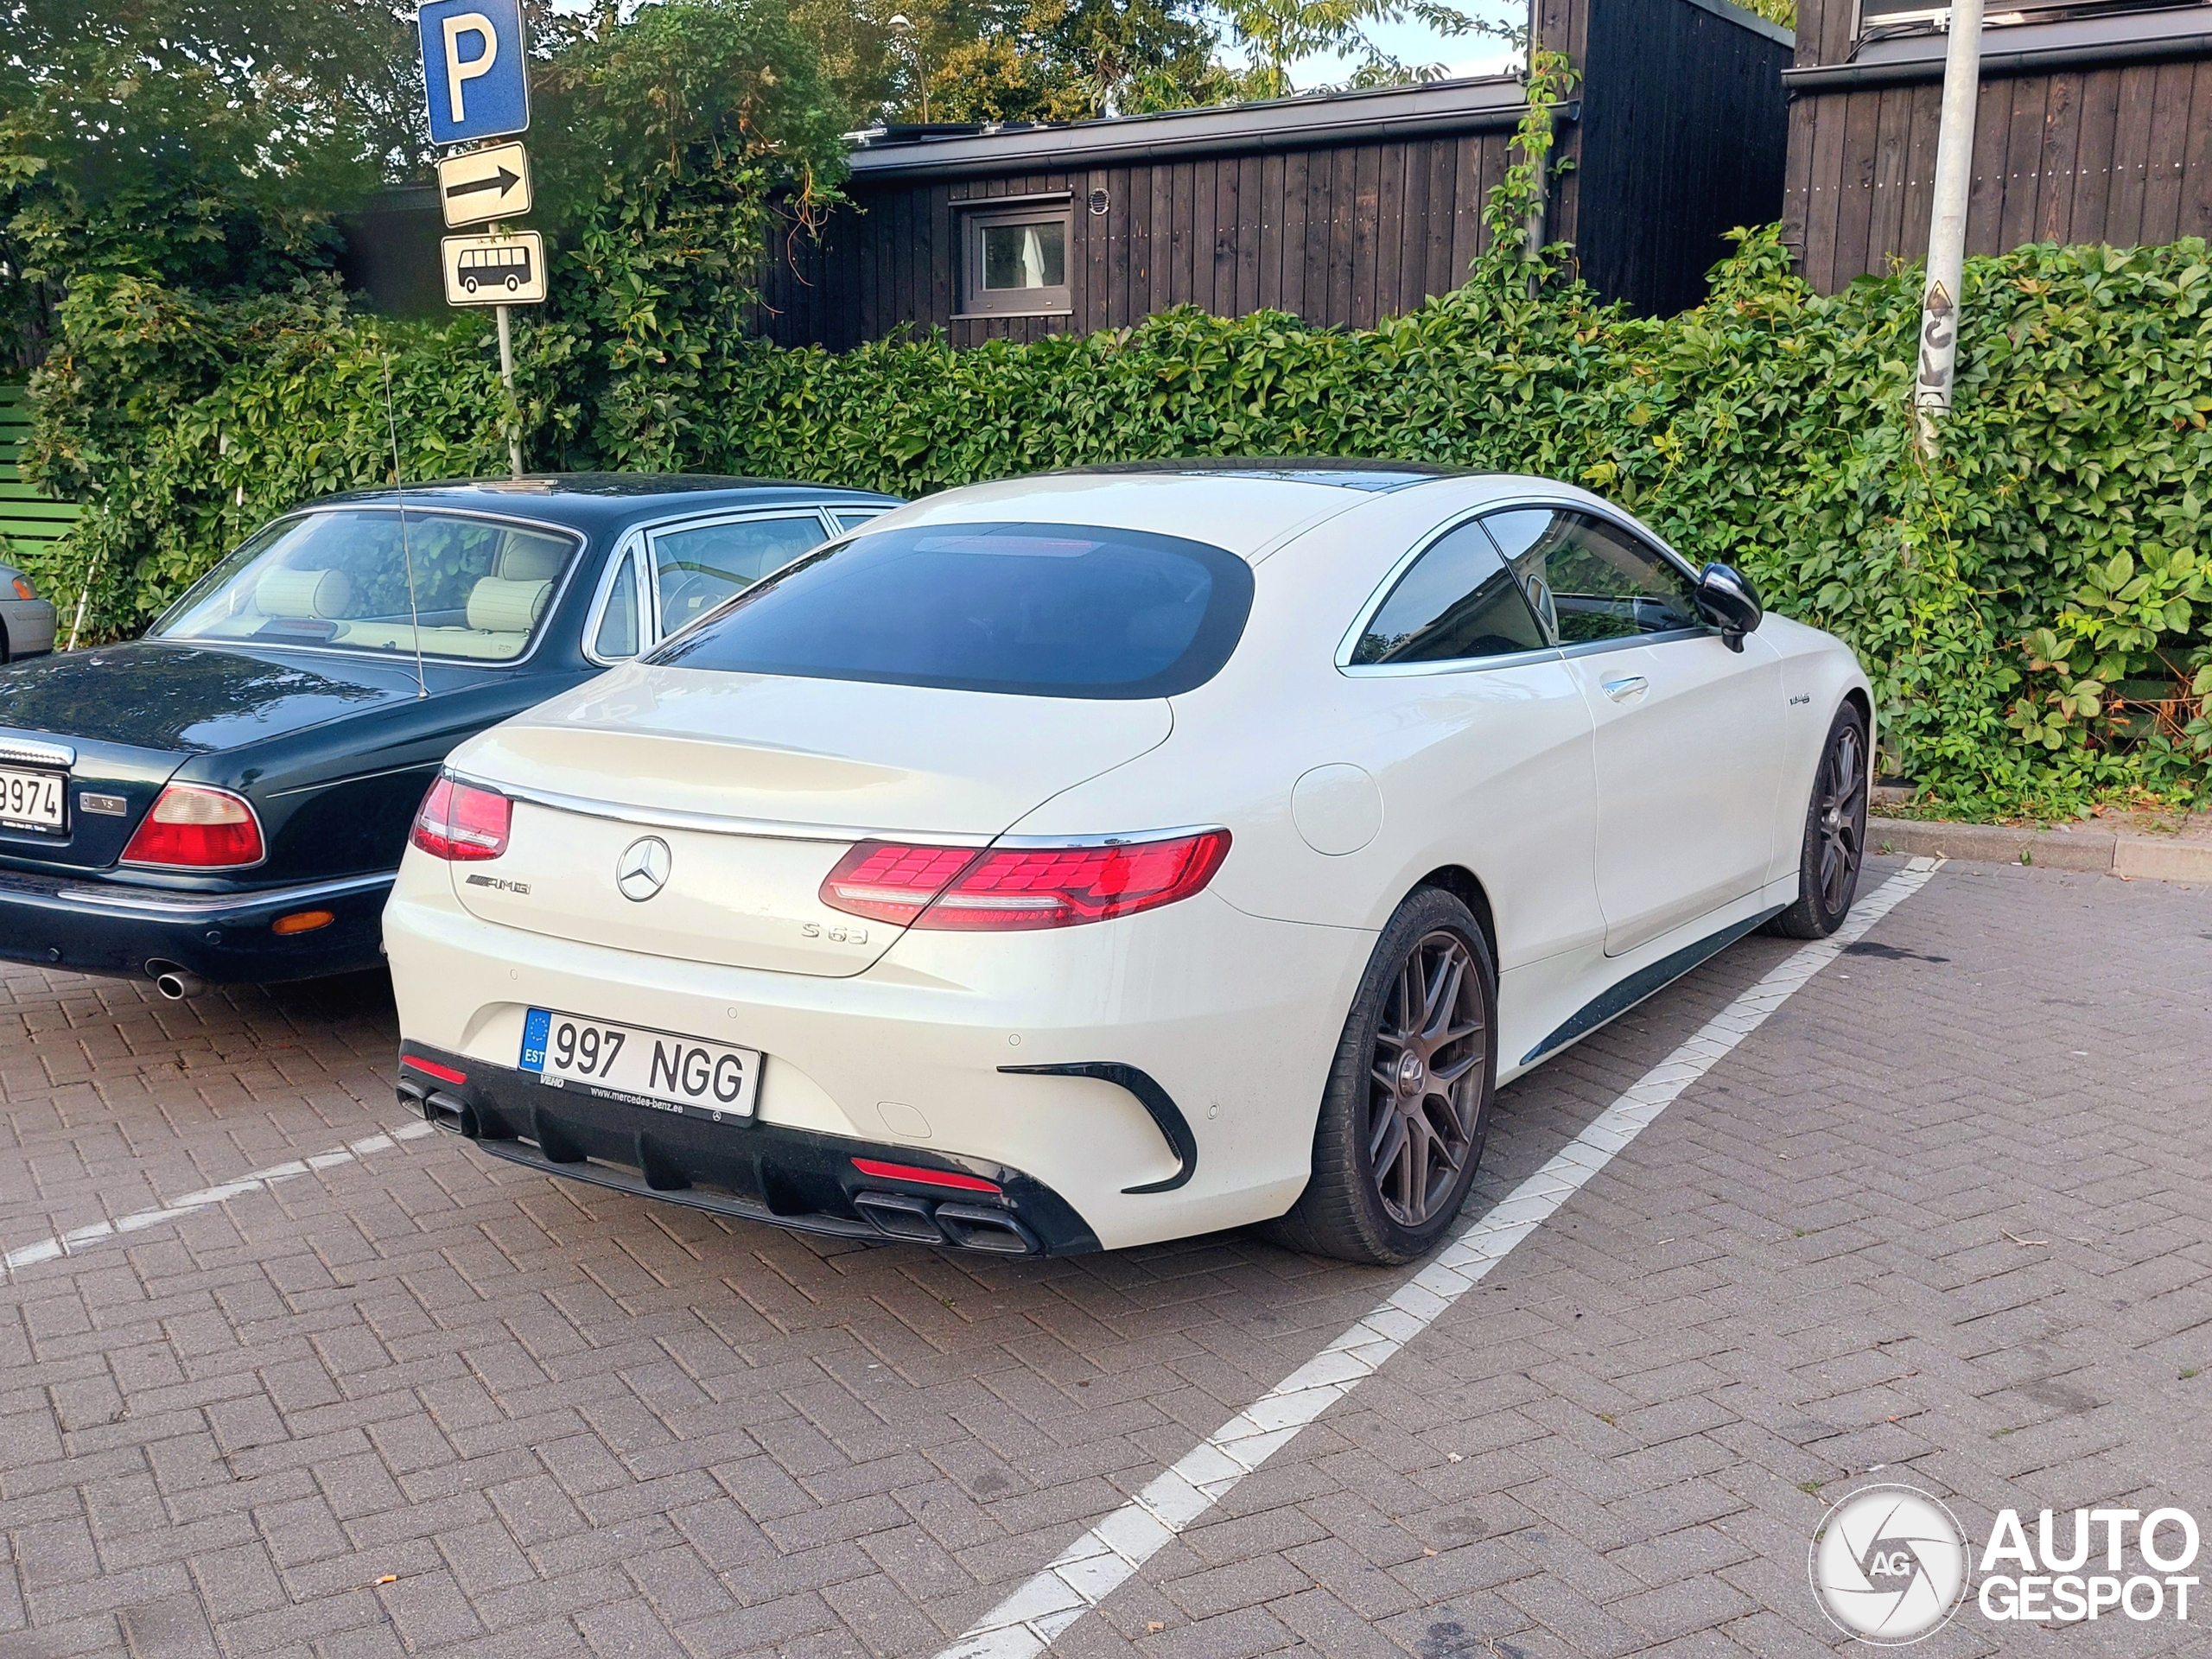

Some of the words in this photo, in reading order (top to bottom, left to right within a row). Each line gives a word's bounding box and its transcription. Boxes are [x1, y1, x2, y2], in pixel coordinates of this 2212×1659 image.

[442, 12, 499, 123] P
[485, 876, 532, 895] AMG
[801, 922, 820, 938] S
[828, 925, 868, 945] 63
[524, 1048, 545, 1065] EST
[554, 1022, 626, 1078] 997
[649, 1039, 744, 1103] NGG
[539, 1074, 565, 1089] VEHO
[590, 1087, 683, 1114] www.mercedes-benz.ee
